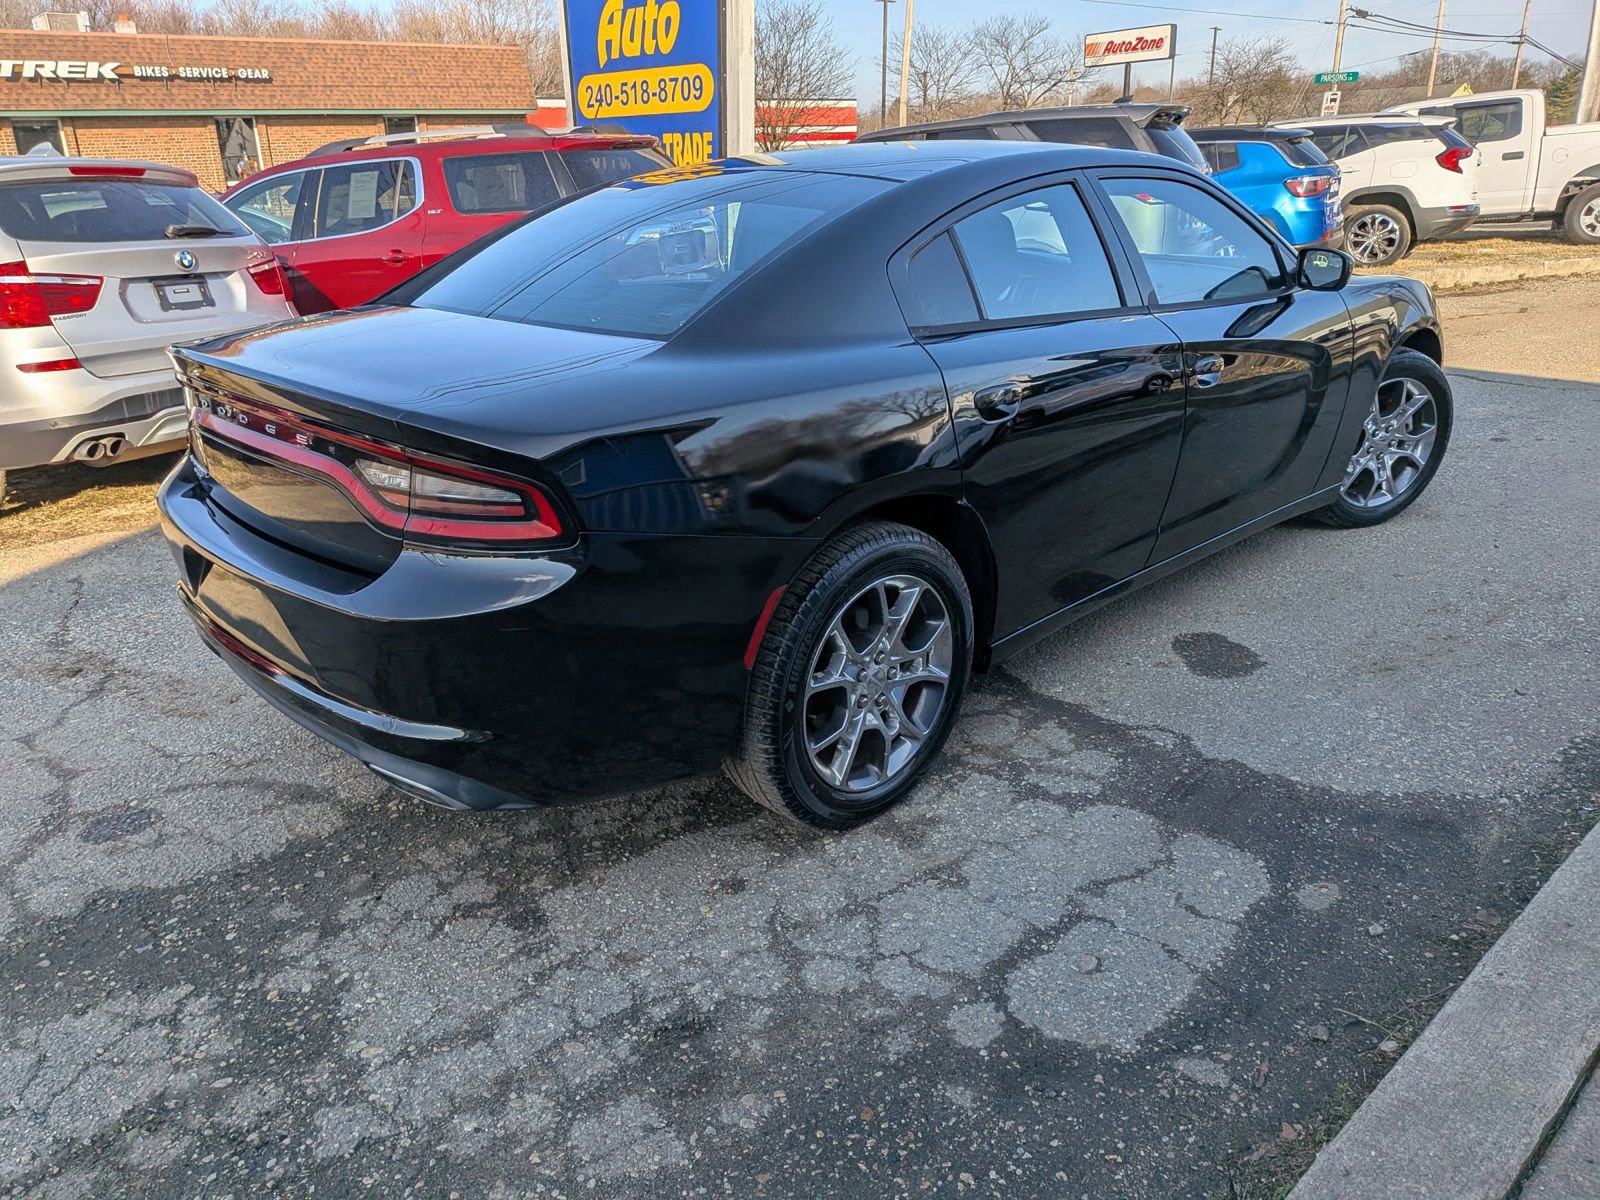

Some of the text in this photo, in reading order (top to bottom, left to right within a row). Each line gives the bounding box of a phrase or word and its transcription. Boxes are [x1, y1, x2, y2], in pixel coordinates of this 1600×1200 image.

[598, 0, 680, 69] Auto
[1103, 36, 1164, 55] AutoZone
[0, 60, 120, 79] TREK
[133, 66, 269, 79] BIKES SERVICE GEAR
[1321, 74, 1347, 83] PARSONS
[585, 75, 703, 108] 240-518-8709
[662, 132, 713, 166] TRADE
[53, 313, 87, 321] PASSPORT
[200, 399, 308, 445] DODGE
